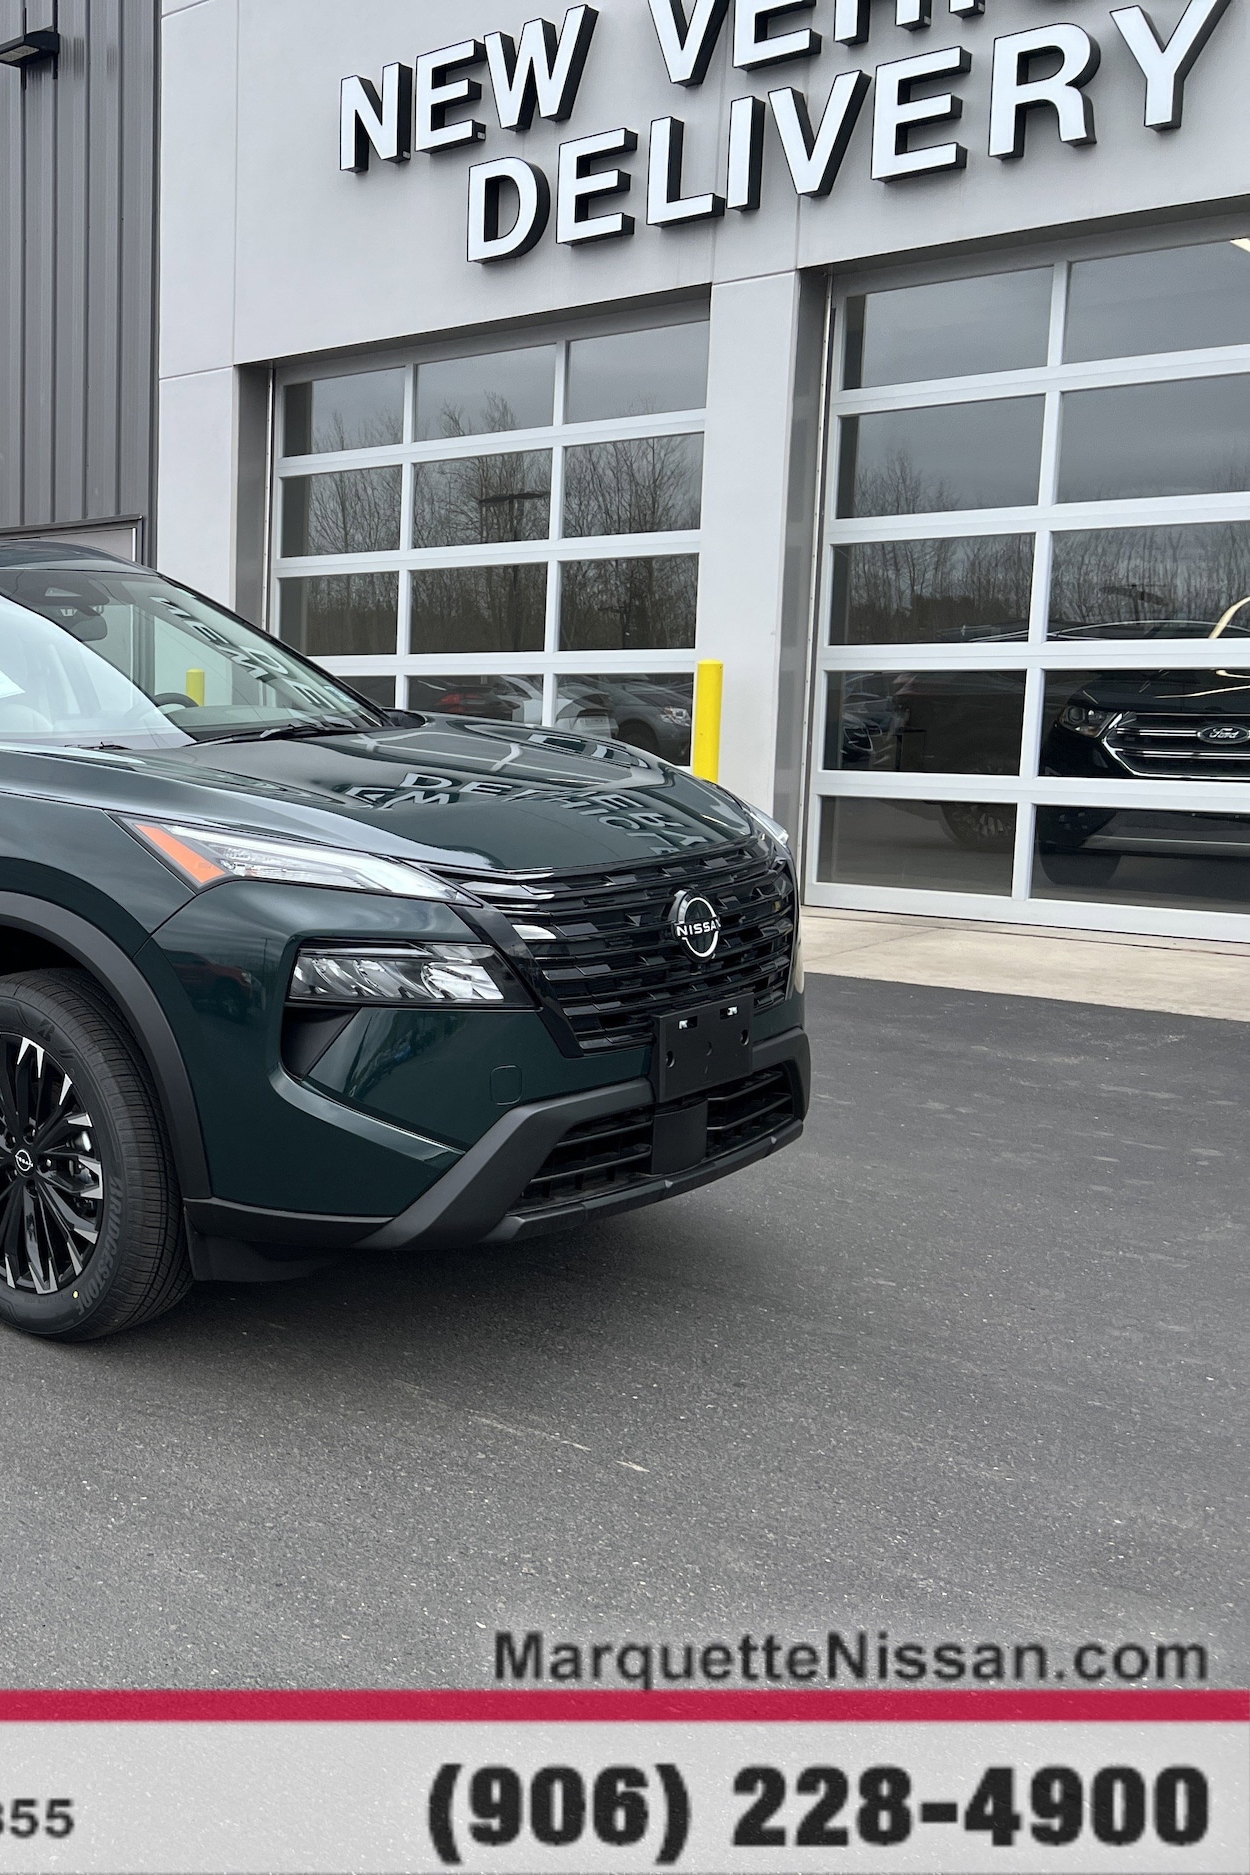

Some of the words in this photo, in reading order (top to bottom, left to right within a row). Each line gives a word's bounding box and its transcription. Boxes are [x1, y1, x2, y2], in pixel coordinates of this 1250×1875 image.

[339, 4, 600, 173] NEW
[466, 0, 1233, 265] DELIVERY
[1209, 727, 1240, 739] Ford
